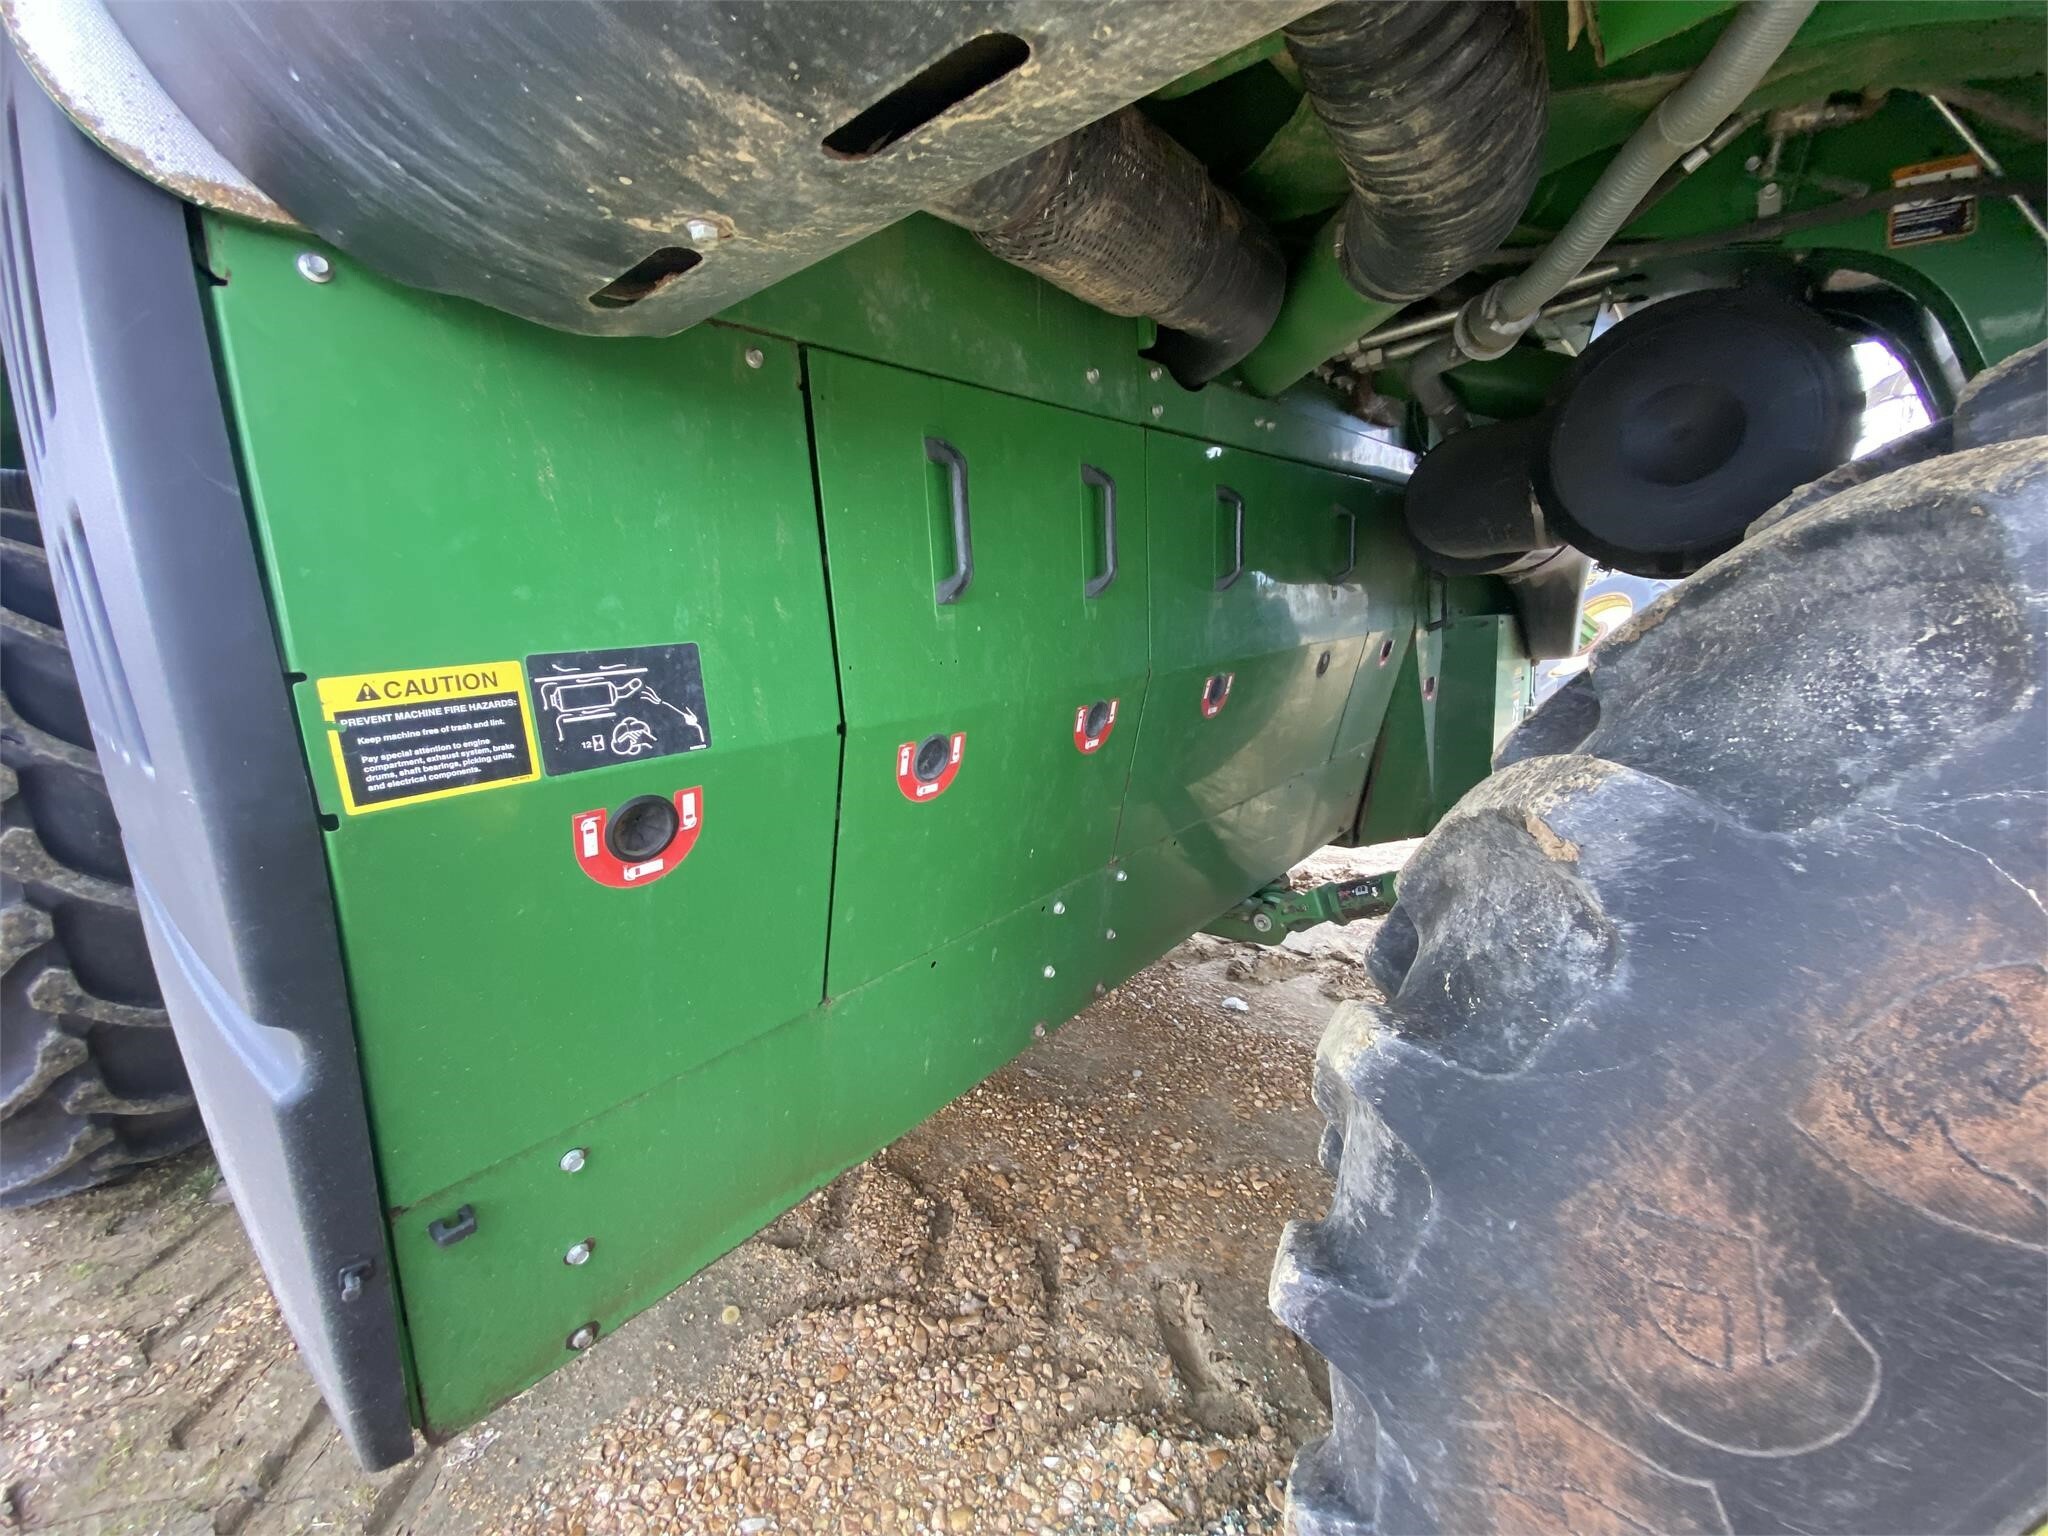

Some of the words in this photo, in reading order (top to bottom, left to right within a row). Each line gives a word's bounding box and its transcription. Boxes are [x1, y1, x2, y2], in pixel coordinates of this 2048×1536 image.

[383, 671, 499, 699] CAUTION
[340, 713, 393, 727] PREVENT
[394, 707, 443, 721] MACHINE
[444, 702, 467, 715] FIRE
[469, 698, 517, 712] HAZARDS:
[357, 736, 381, 745] Keep
[383, 731, 421, 741] machine
[422, 725, 439, 735] free
[440, 725, 450, 733] of
[450, 722, 472, 732] trash
[473, 720, 489, 729] and
[490, 718, 506, 727] lint.
[581, 740, 593, 749] 12
[361, 755, 379, 764] Pay
[380, 749, 413, 761] special
[414, 743, 451, 755] attention
[463, 738, 491, 748] engine
[363, 757, 426, 773] compartment,
[426, 751, 460, 763] exhaust
[460, 747, 492, 758] system,
[492, 743, 515, 752] brake
[365, 771, 398, 782] drums,
[399, 766, 421, 777] shaft
[422, 760, 462, 772] bearings,
[462, 756, 492, 767] picking
[492, 752, 515, 761] units,
[367, 781, 386, 791] and
[386, 774, 428, 788] electrical
[428, 766, 481, 781] components.
